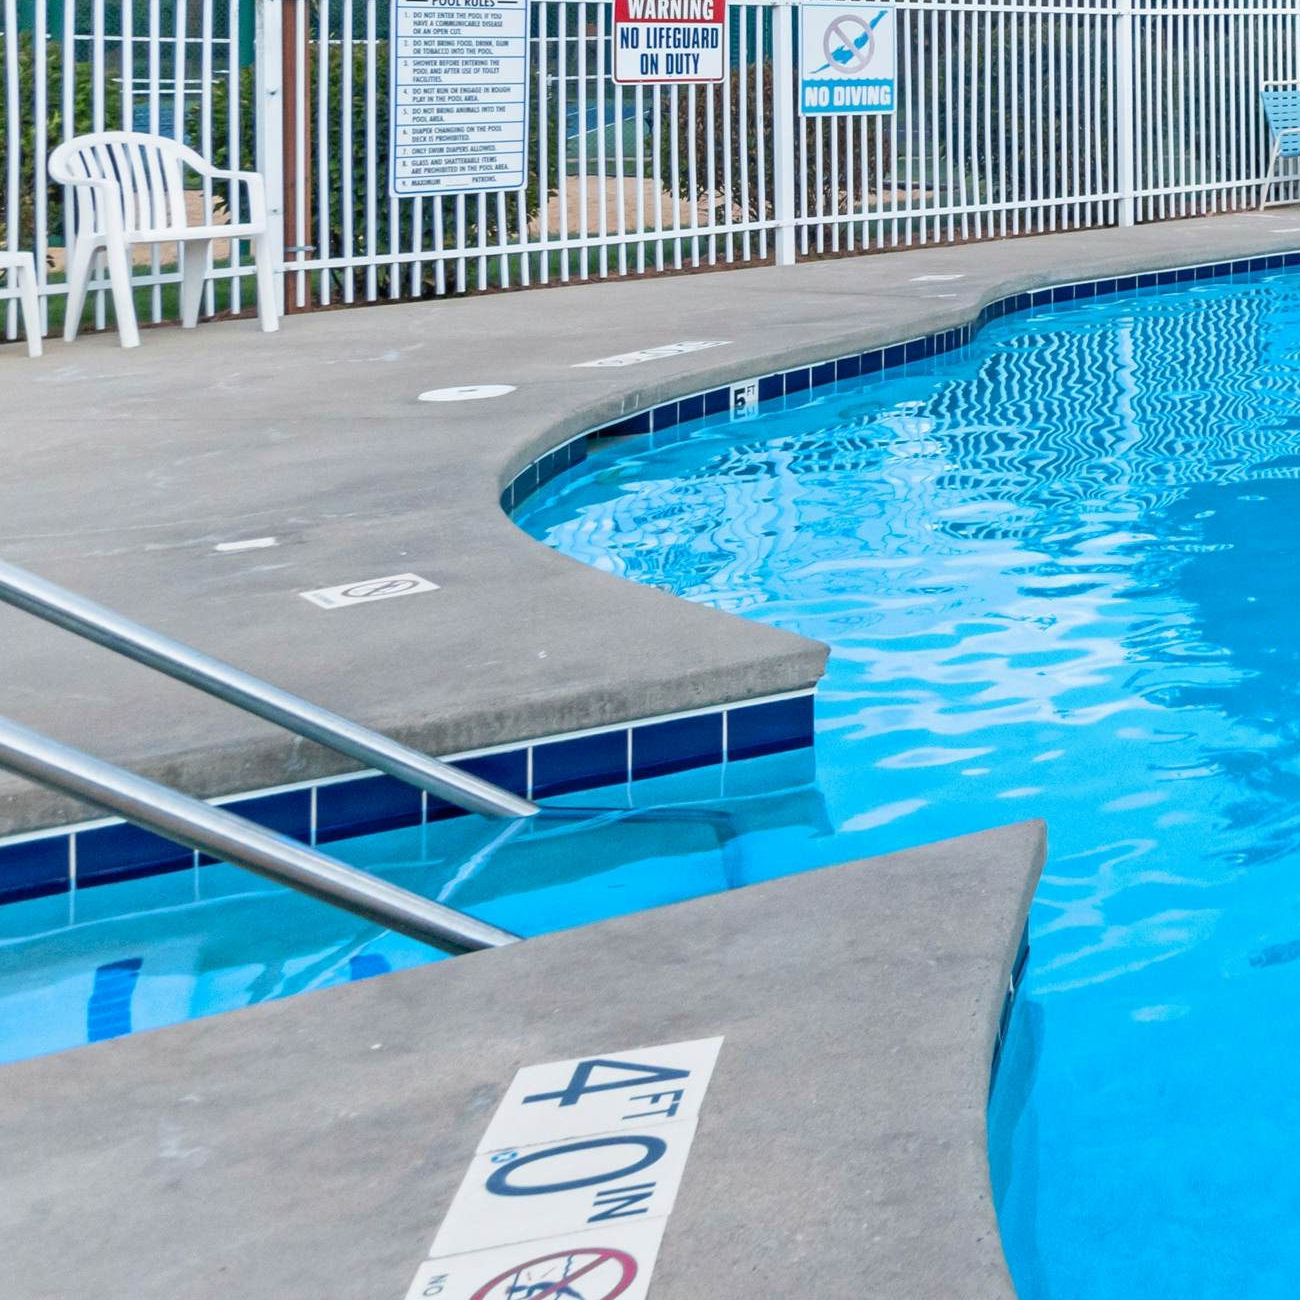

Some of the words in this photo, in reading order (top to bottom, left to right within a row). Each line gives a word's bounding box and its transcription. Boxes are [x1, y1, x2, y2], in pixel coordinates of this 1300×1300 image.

[620, 27, 639, 48] NO
[646, 27, 718, 48] LIFEGUARD
[640, 54, 658, 75] ON
[666, 54, 699, 74] DUTY
[805, 86, 830, 107] NO
[833, 85, 891, 106] DIVING
[747, 385, 755, 396] FT
[522, 1059, 690, 1108] 4
[622, 1089, 684, 1120] FT
[485, 1135, 668, 1196] 0
[586, 1182, 657, 1224] IN
